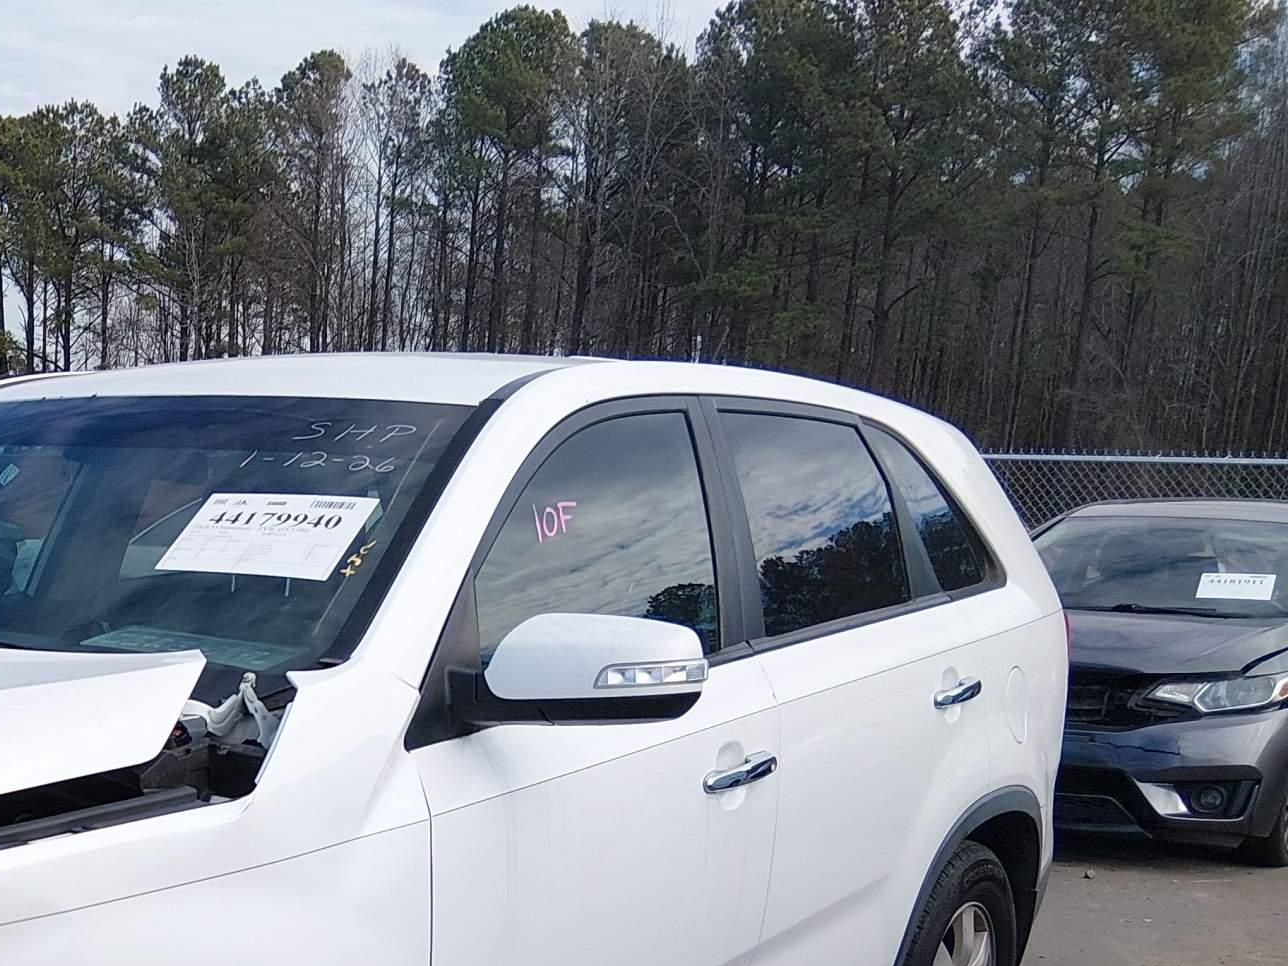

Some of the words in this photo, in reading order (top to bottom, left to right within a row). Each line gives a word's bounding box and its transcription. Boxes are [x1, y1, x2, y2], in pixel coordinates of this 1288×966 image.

[292, 422, 417, 443] SHP
[239, 449, 395, 474] 1-12-26
[210, 510, 344, 531] 44179940
